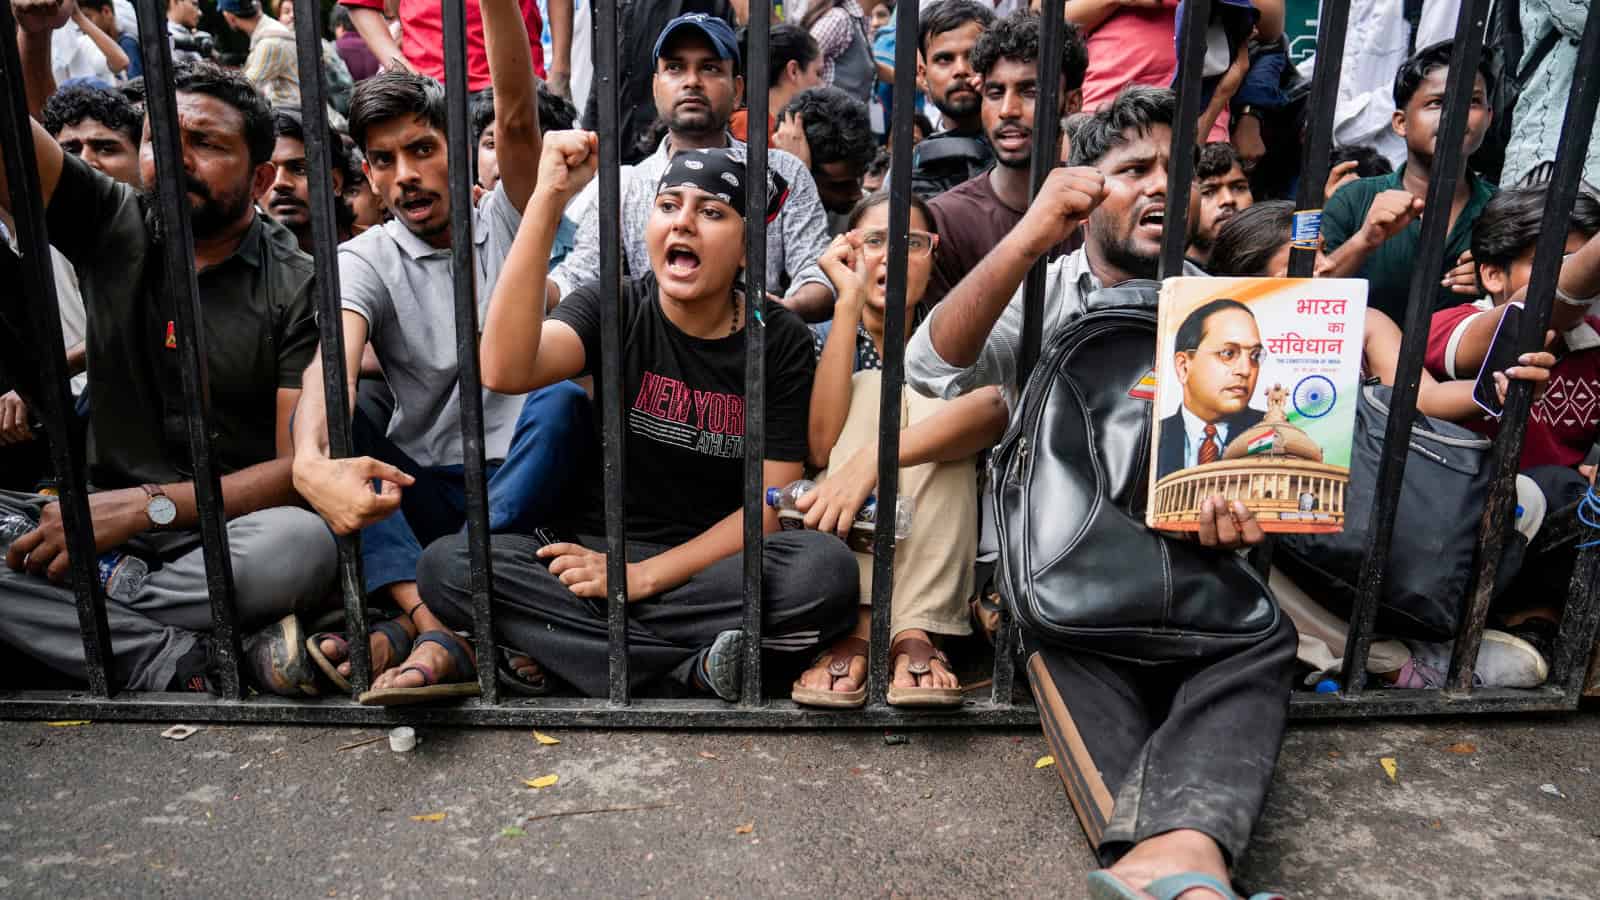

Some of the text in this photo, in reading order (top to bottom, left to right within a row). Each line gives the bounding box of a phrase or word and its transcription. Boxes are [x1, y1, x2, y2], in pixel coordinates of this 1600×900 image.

[1297, 299, 1347, 315] भारत
[1328, 322, 1345, 333] का
[1266, 332, 1344, 354] संविधान
[634, 371, 745, 435] NEW YOR
